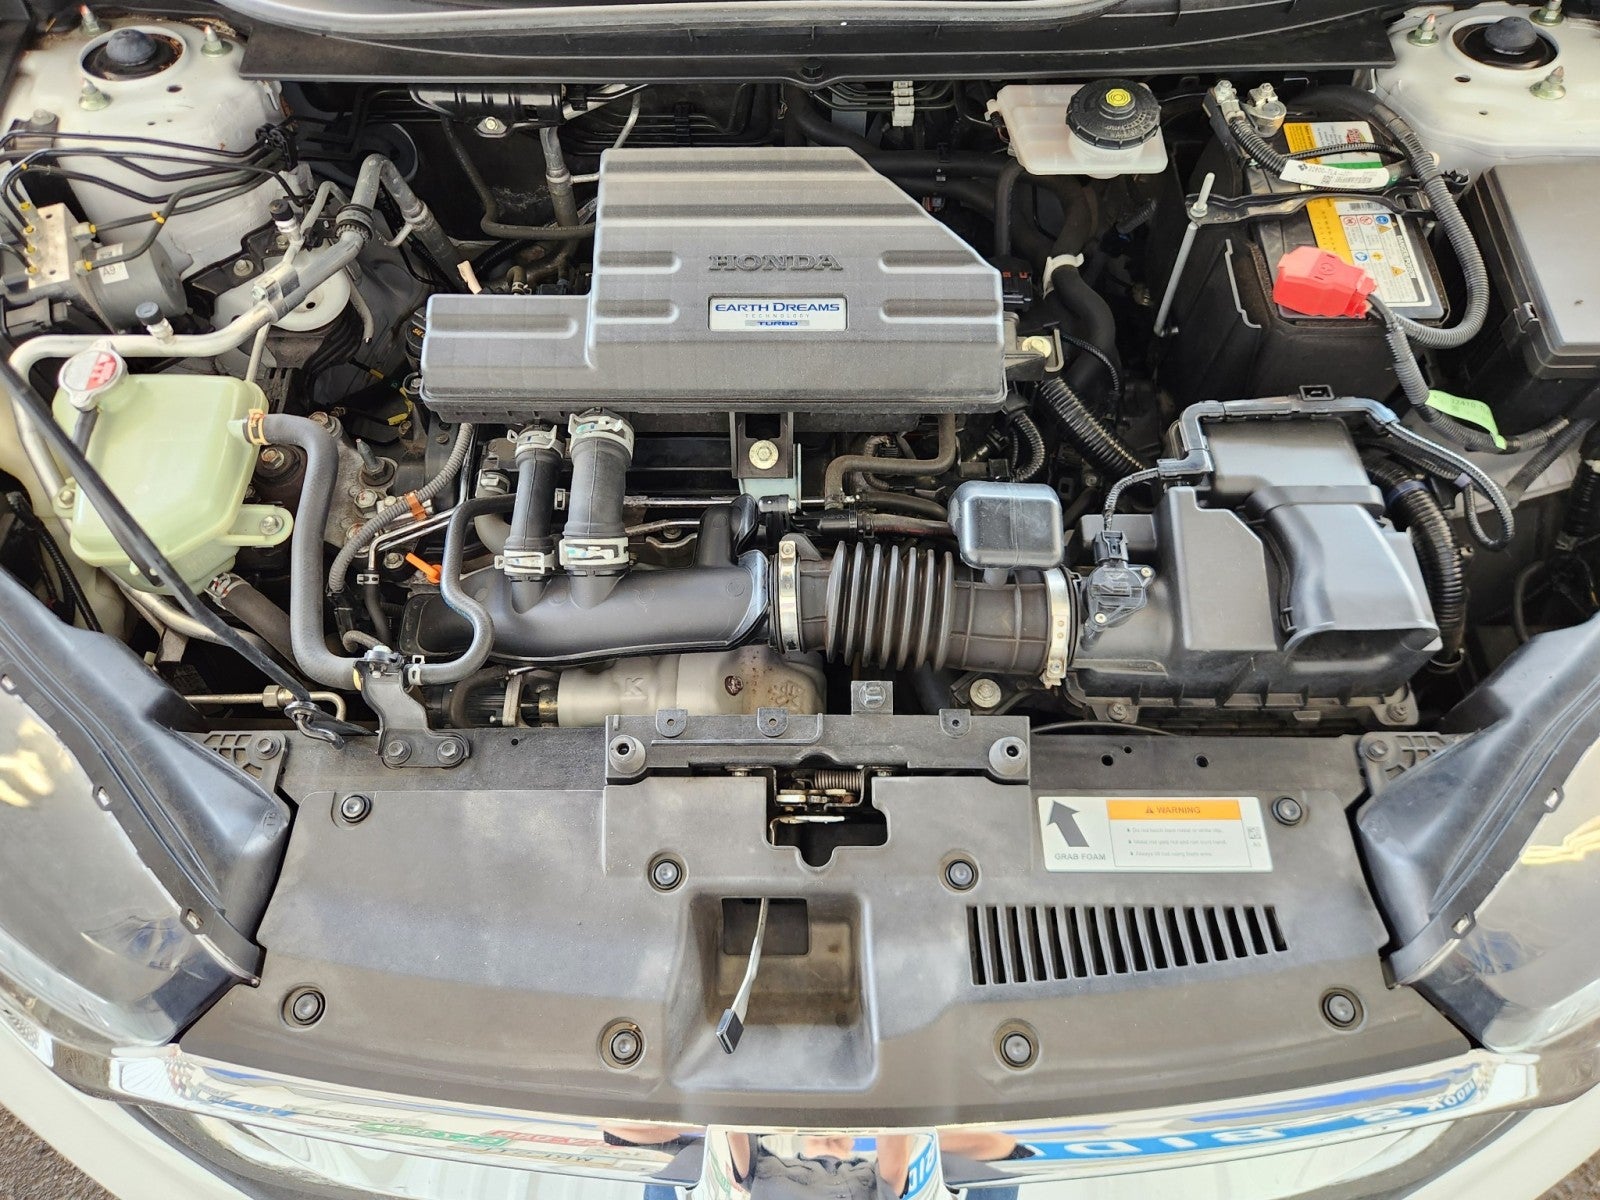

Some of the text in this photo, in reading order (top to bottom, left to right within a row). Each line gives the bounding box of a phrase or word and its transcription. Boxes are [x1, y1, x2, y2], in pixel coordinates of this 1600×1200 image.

[709, 254, 843, 272] HONDA
[715, 302, 840, 312] EARTH DREAMS
[1156, 806, 1201, 815] WARNING
[1054, 853, 1106, 861] GRAB FOAM
